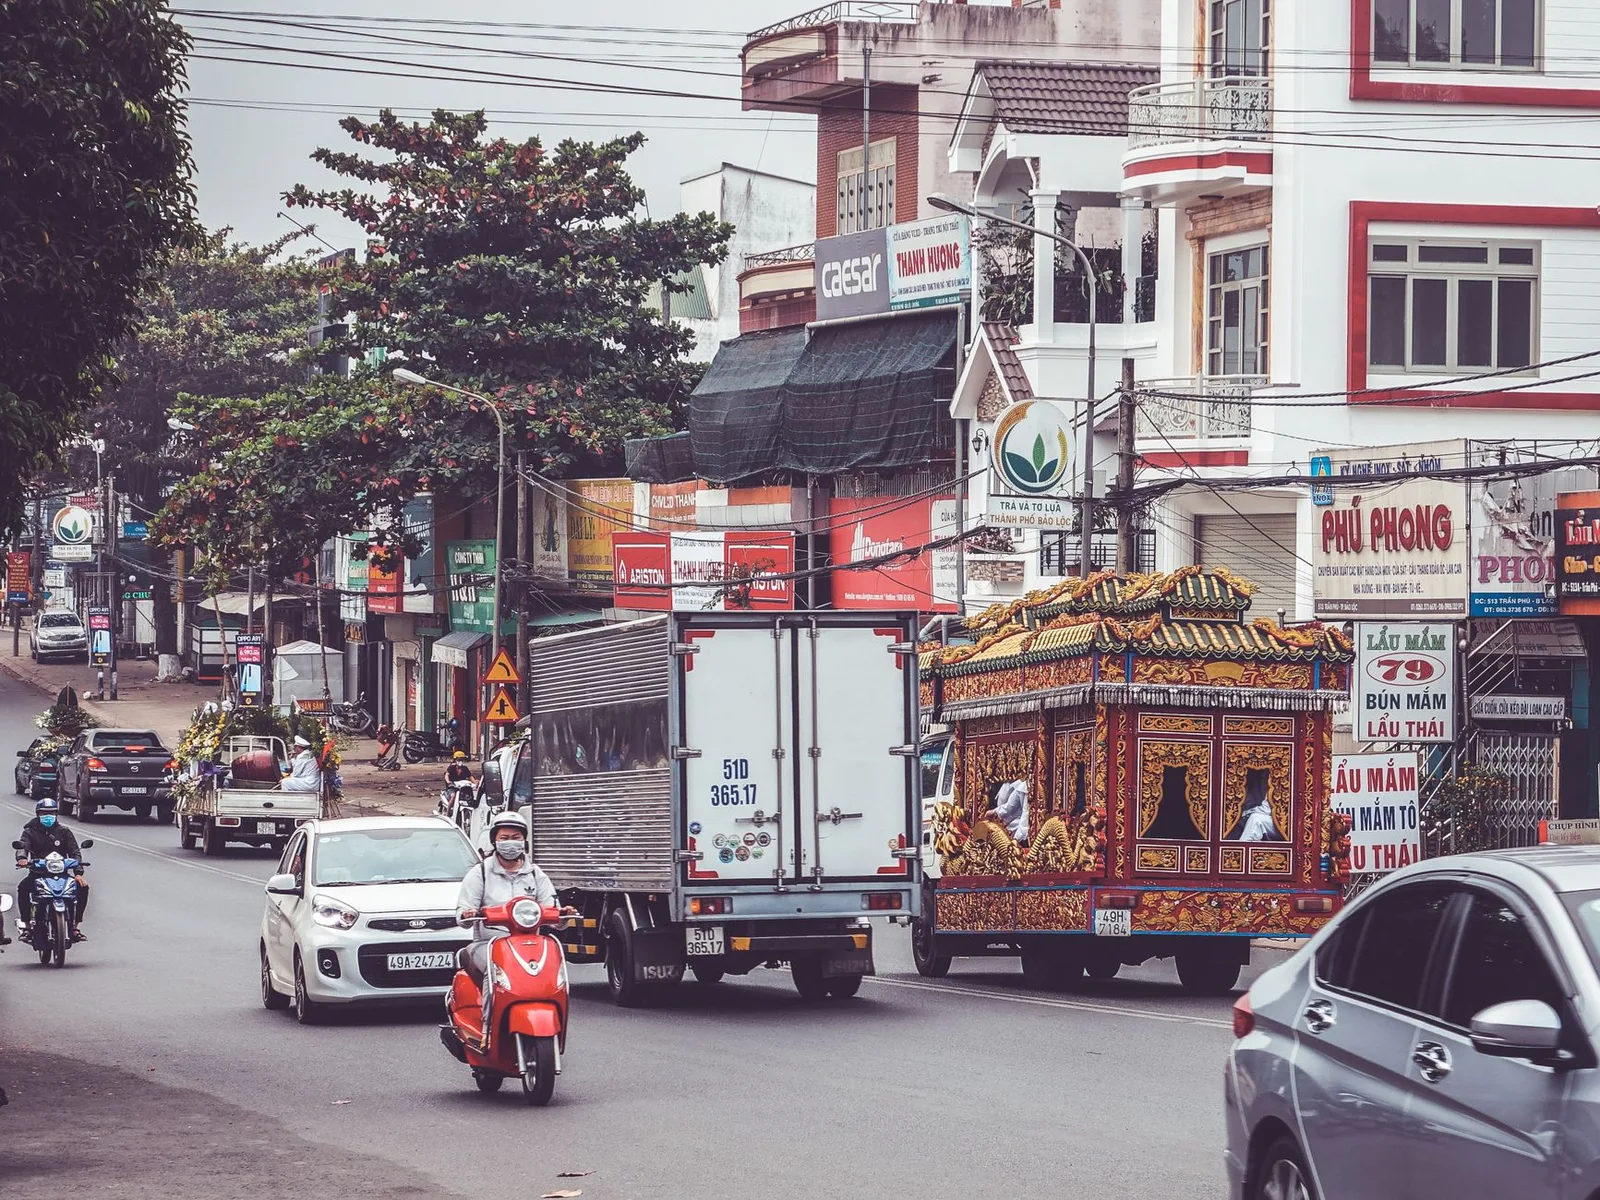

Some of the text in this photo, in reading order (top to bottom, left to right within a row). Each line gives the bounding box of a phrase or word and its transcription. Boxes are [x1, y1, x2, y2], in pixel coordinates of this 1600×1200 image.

[896, 248, 926, 278] THANH
[821, 253, 882, 299] caesar
[1000, 501, 1017, 511] TRÀ
[1019, 500, 1029, 512] VÀ
[990, 514, 1017, 525] THÀNH
[1019, 513, 1035, 525] PHỐ
[1037, 513, 1054, 525] BẢO
[1322, 495, 1453, 554] PHÚ PHONG
[630, 568, 665, 585] ARISTON
[1517, 596, 1531, 604] PHÚ
[1366, 626, 1447, 651] LẨU MẮM
[1375, 658, 1435, 682] 79
[1365, 686, 1448, 710] BÚN MẮM
[1529, 703, 1543, 716] LOAN
[1542, 703, 1553, 716] CAO
[1367, 713, 1445, 738] LẨU THÁI
[723, 758, 749, 780] 51D
[1367, 757, 1416, 793] MẮM
[710, 783, 758, 806] 365.17
[1360, 797, 1399, 831] MẮM
[1399, 799, 1417, 830] TÔ
[1548, 820, 1599, 832] CHỤP HÌNH
[1372, 839, 1418, 870] THÁI
[1102, 910, 1124, 923] 49H
[694, 928, 715, 941] 51D
[1099, 923, 1127, 935] 7184
[687, 941, 723, 954] 365.17
[389, 954, 452, 970] 49A-247.24
